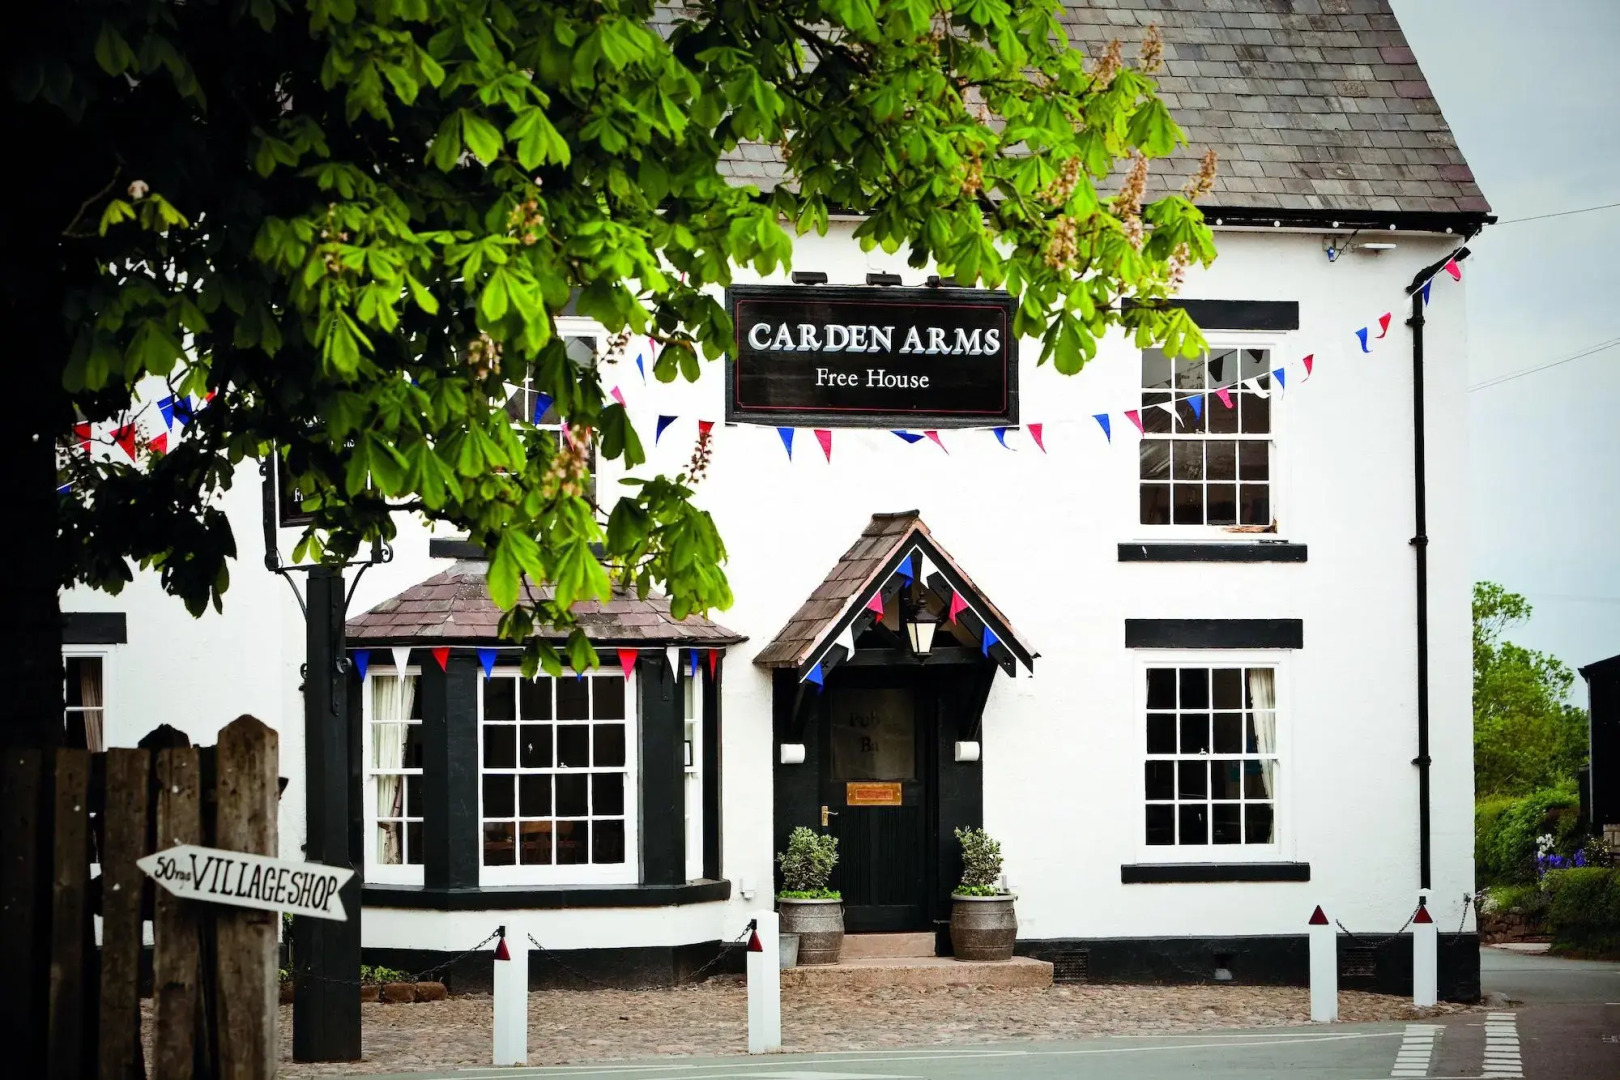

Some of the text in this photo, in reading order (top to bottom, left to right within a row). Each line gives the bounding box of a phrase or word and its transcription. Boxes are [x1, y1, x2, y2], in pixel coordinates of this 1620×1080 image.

[748, 322, 1001, 356] CARDEN ARMS
[815, 368, 930, 388] Free House
